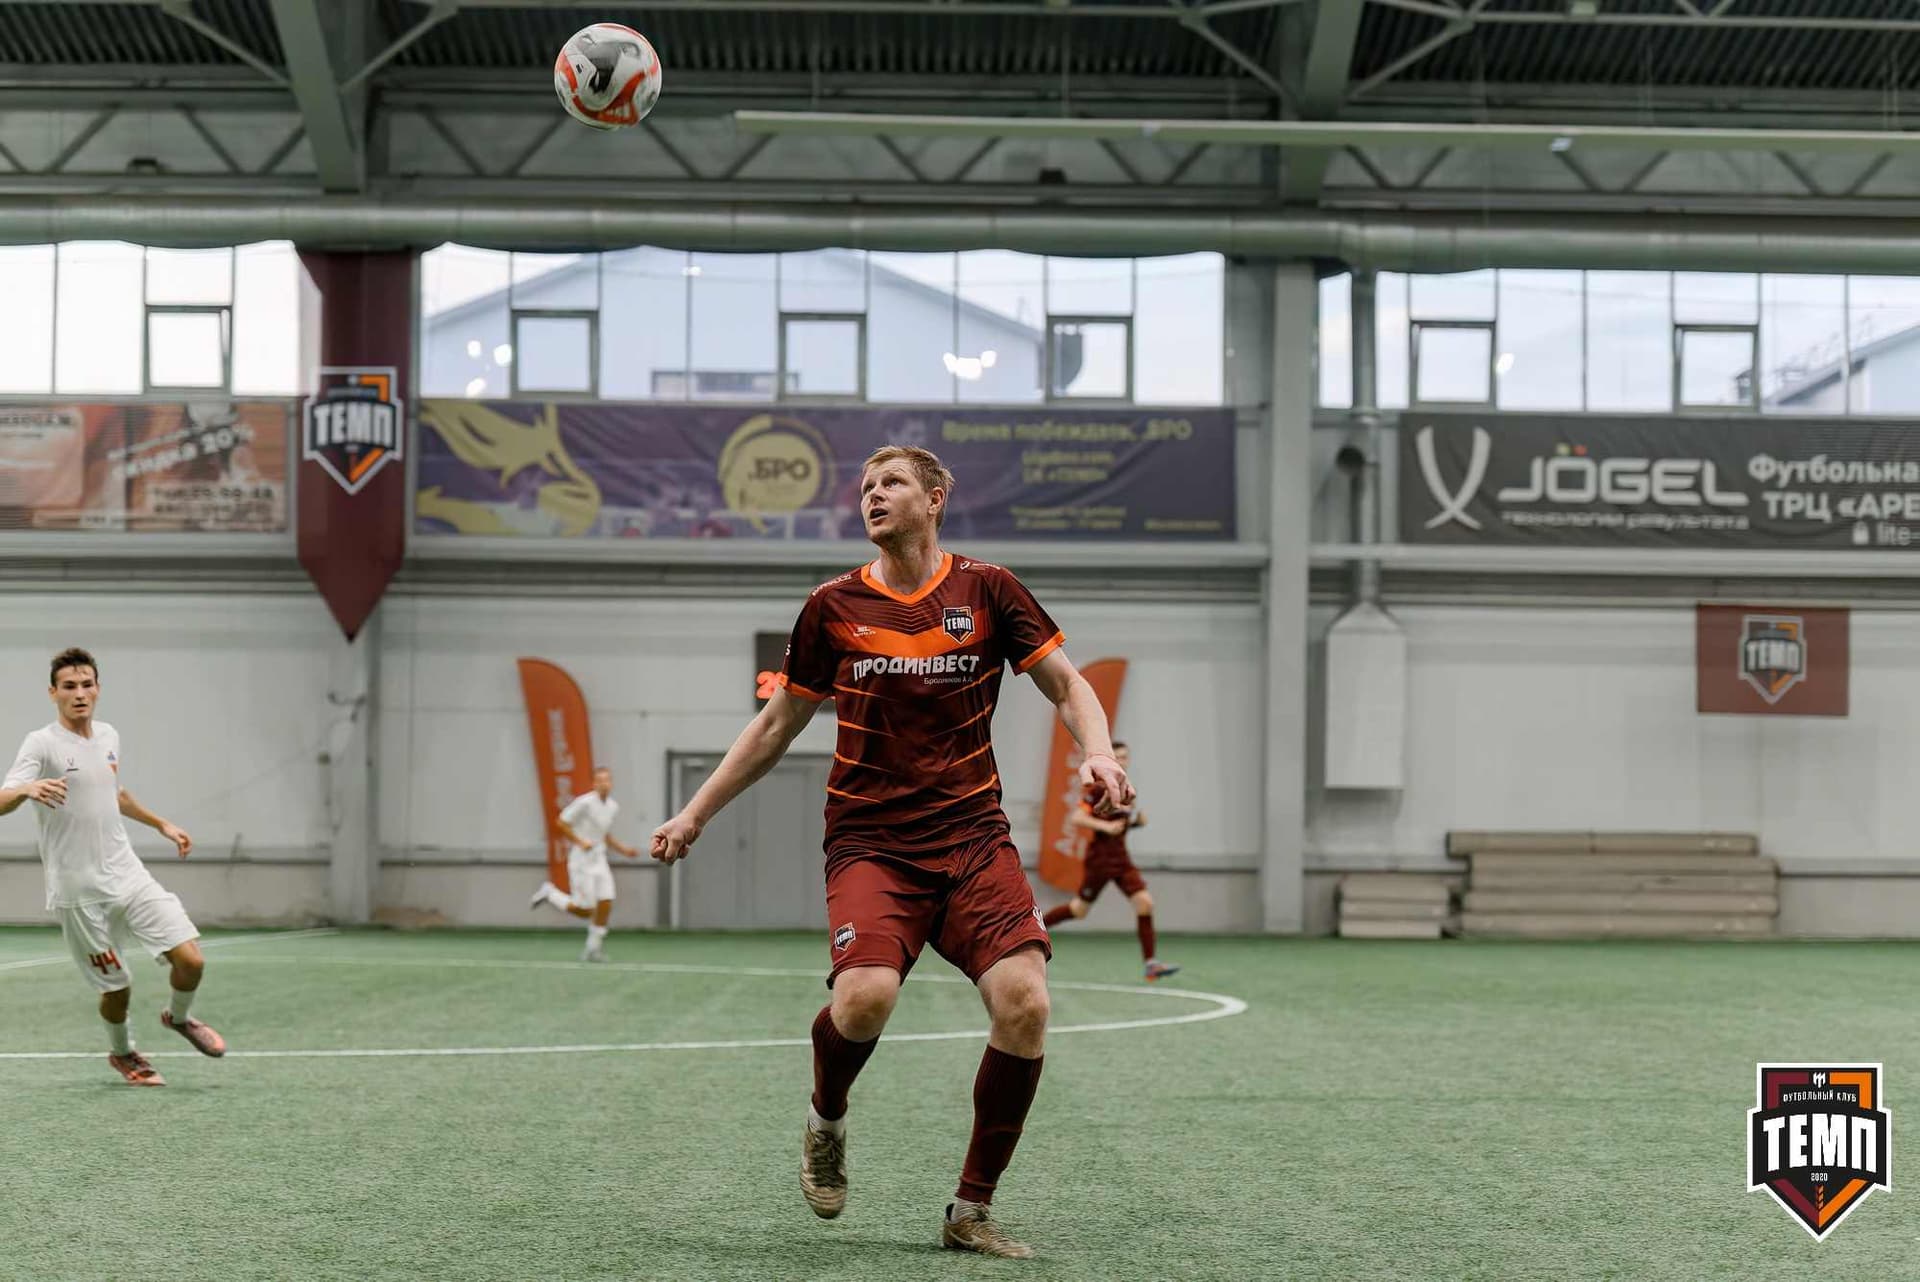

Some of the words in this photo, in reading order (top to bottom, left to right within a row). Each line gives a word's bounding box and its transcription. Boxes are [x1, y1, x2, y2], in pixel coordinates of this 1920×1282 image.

[313, 401, 393, 447] ТЕМП
[1498, 442, 1749, 506] JÖGEL
[1762, 492, 1832, 523] ТРЦ
[945, 616, 972, 631] ТЕМП
[853, 655, 980, 682] ПРОДИНВЕСТ
[1746, 640, 1800, 672] ТЕМП
[88, 948, 122, 975] 44
